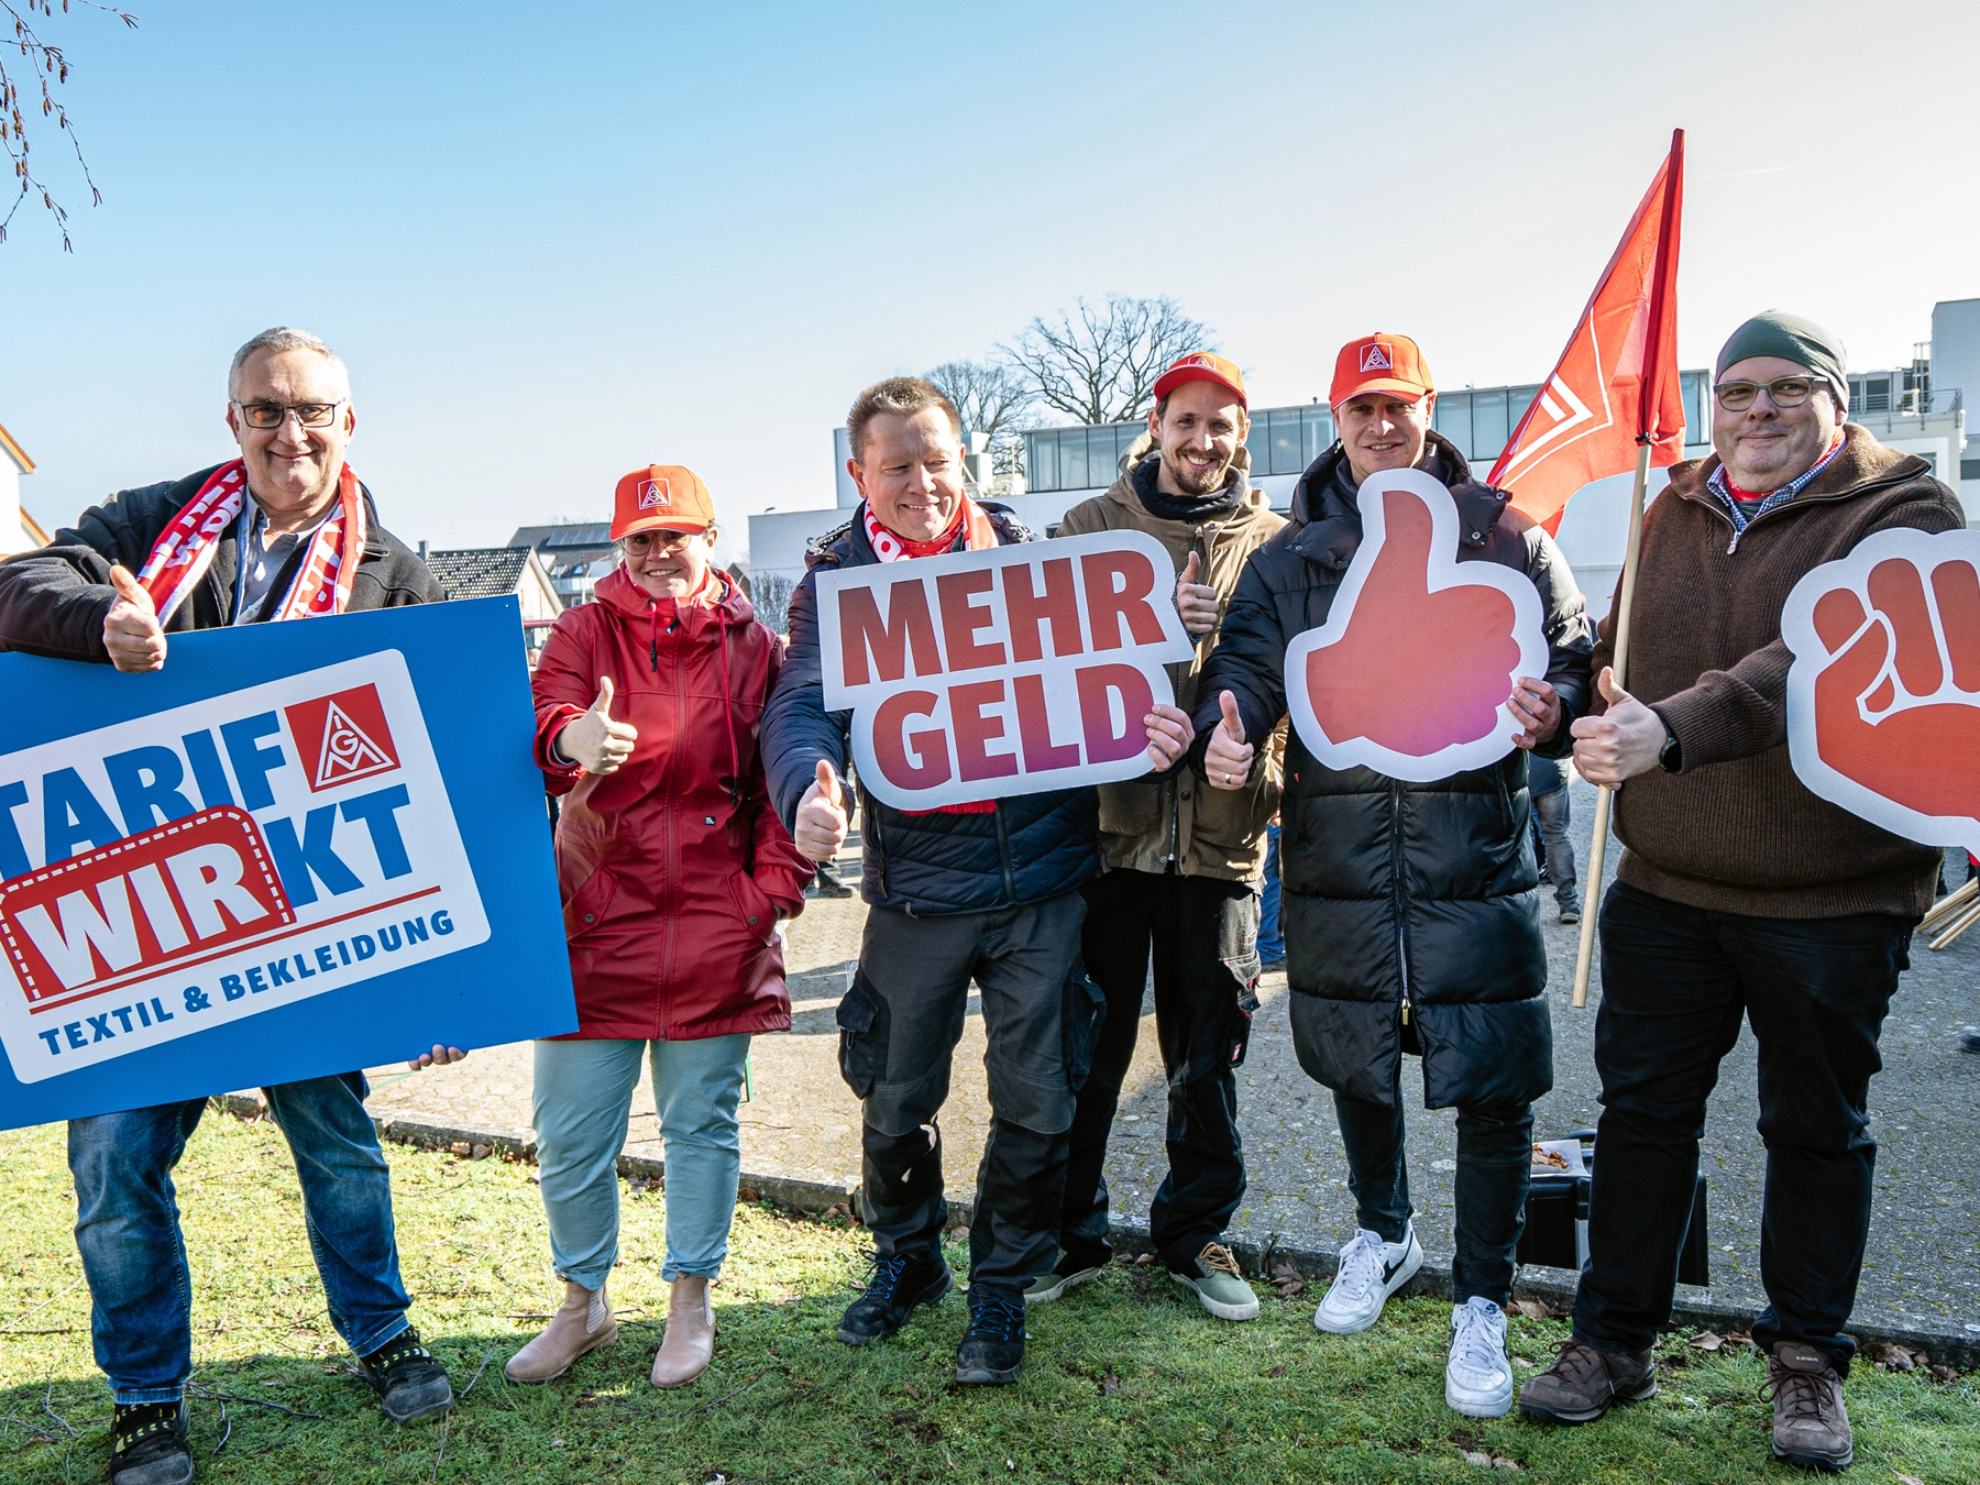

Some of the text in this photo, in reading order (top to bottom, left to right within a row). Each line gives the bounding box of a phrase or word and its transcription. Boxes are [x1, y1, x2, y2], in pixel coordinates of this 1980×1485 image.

[838, 550, 1167, 687] MEHR
[873, 663, 1155, 790] GELD
[39, 909, 455, 1055] TEXTIL & BEKLEIDUNG
